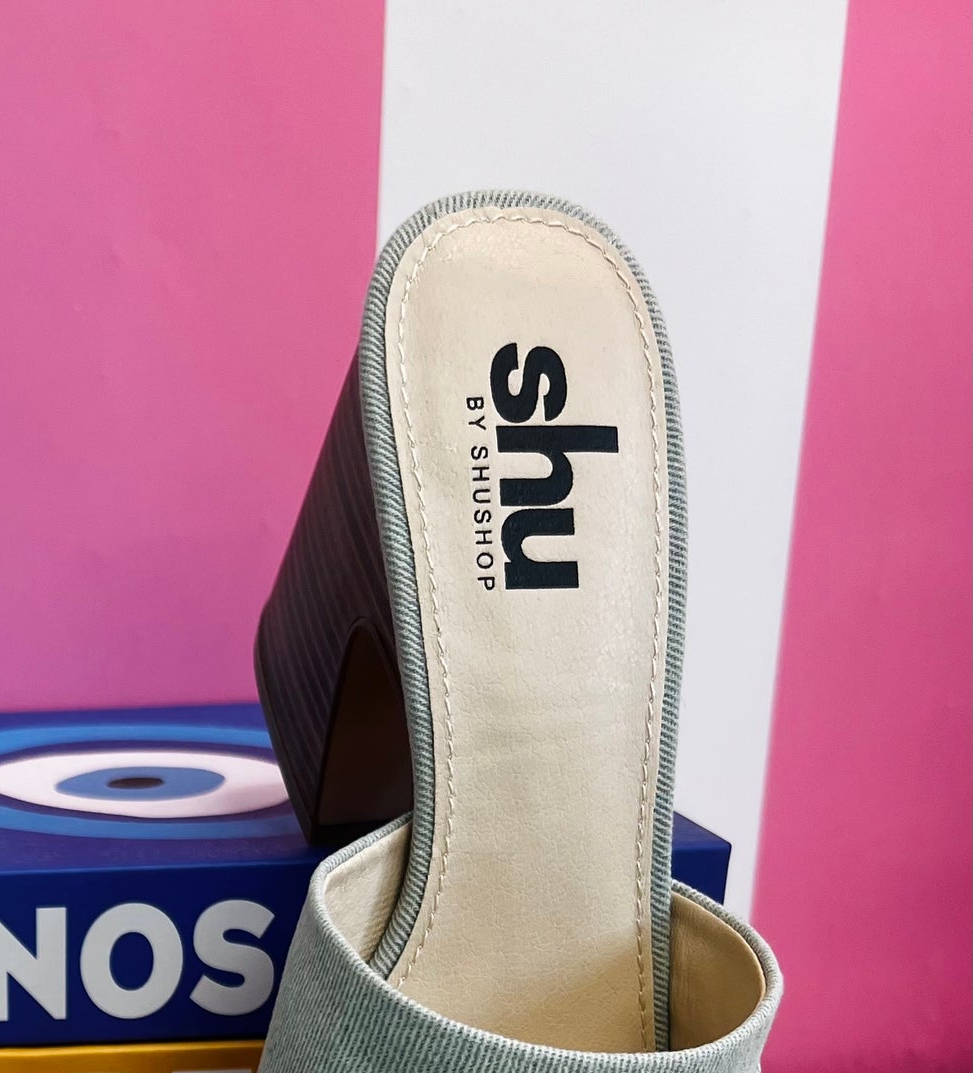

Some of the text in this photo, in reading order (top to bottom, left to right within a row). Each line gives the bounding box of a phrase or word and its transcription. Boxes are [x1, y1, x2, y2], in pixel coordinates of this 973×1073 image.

[466, 396, 495, 591] BY SHUSHOP
[490, 342, 619, 590] shu
